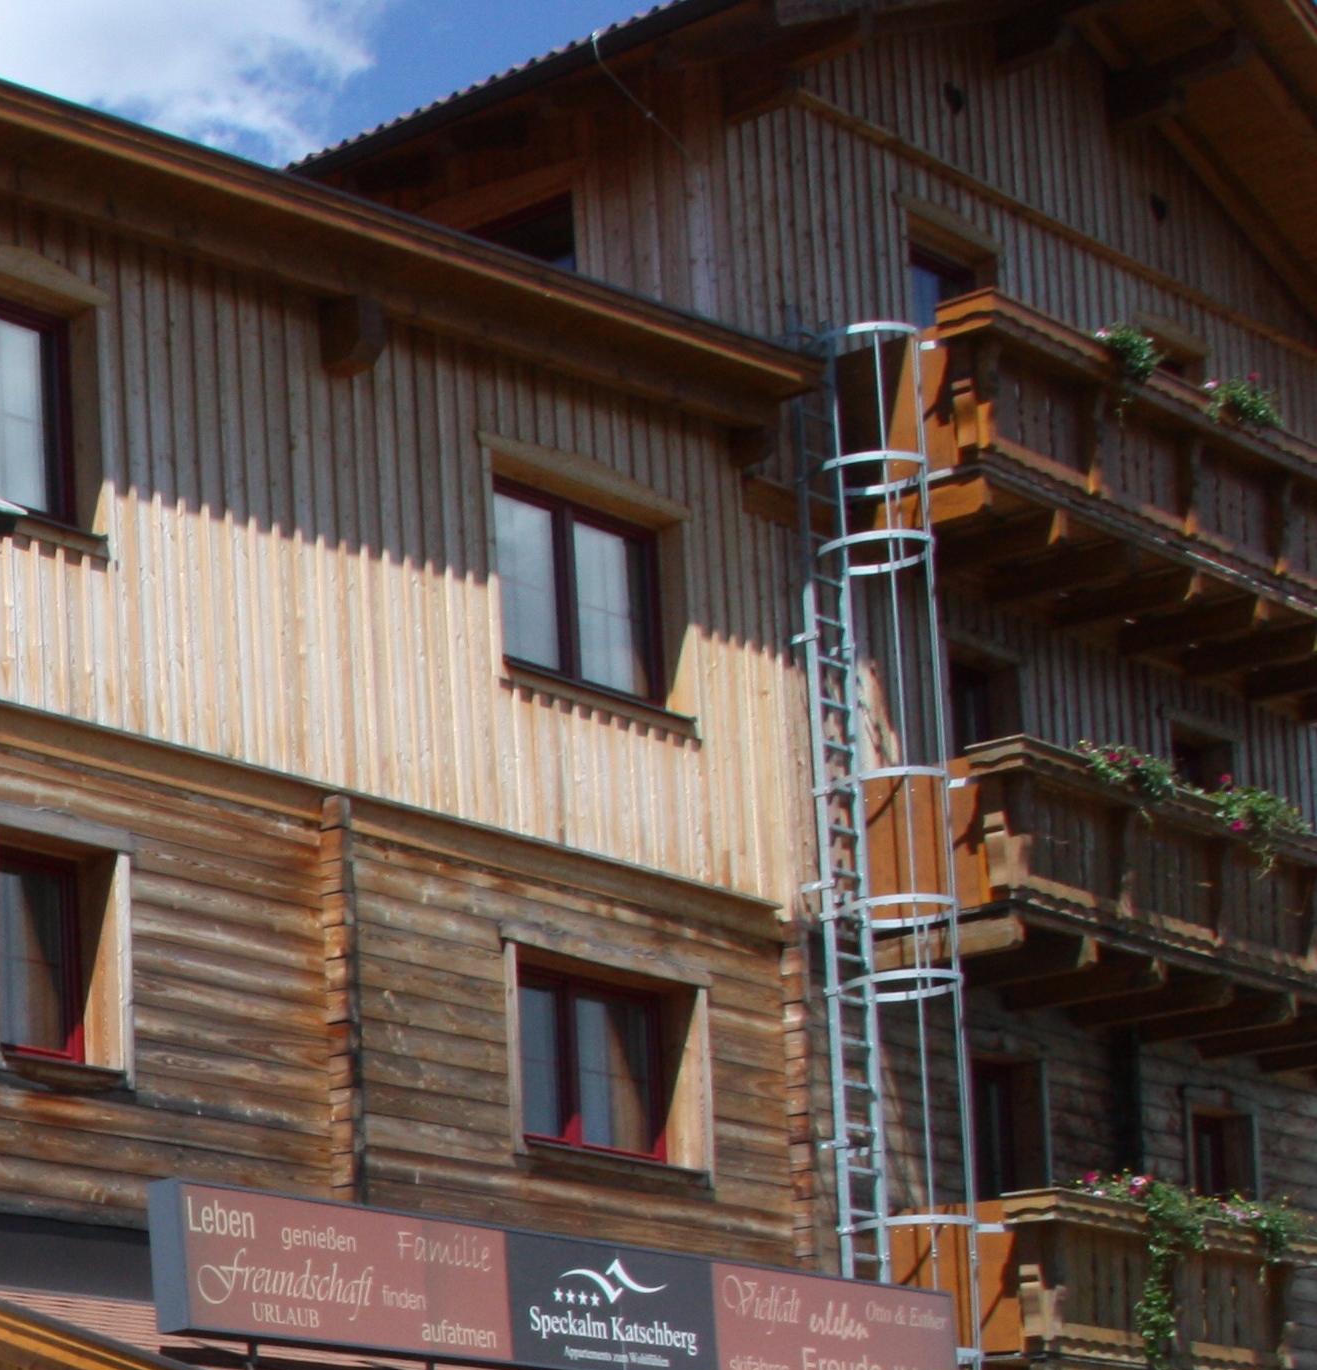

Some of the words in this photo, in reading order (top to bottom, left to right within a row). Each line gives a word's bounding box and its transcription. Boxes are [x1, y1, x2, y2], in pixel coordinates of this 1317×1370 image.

[187, 1196, 255, 1239] Leben
[281, 1225, 357, 1252] genießen
[396, 1230, 493, 1273] Familie
[381, 1284, 427, 1311] finden
[721, 1274, 801, 1335] Vielfalt
[894, 1305, 905, 1326] &
[251, 1302, 320, 1329] URLAUB
[421, 1319, 497, 1349] aufatmen
[529, 1305, 607, 1339] Speckalm
[610, 1316, 698, 1356] Katschberg
